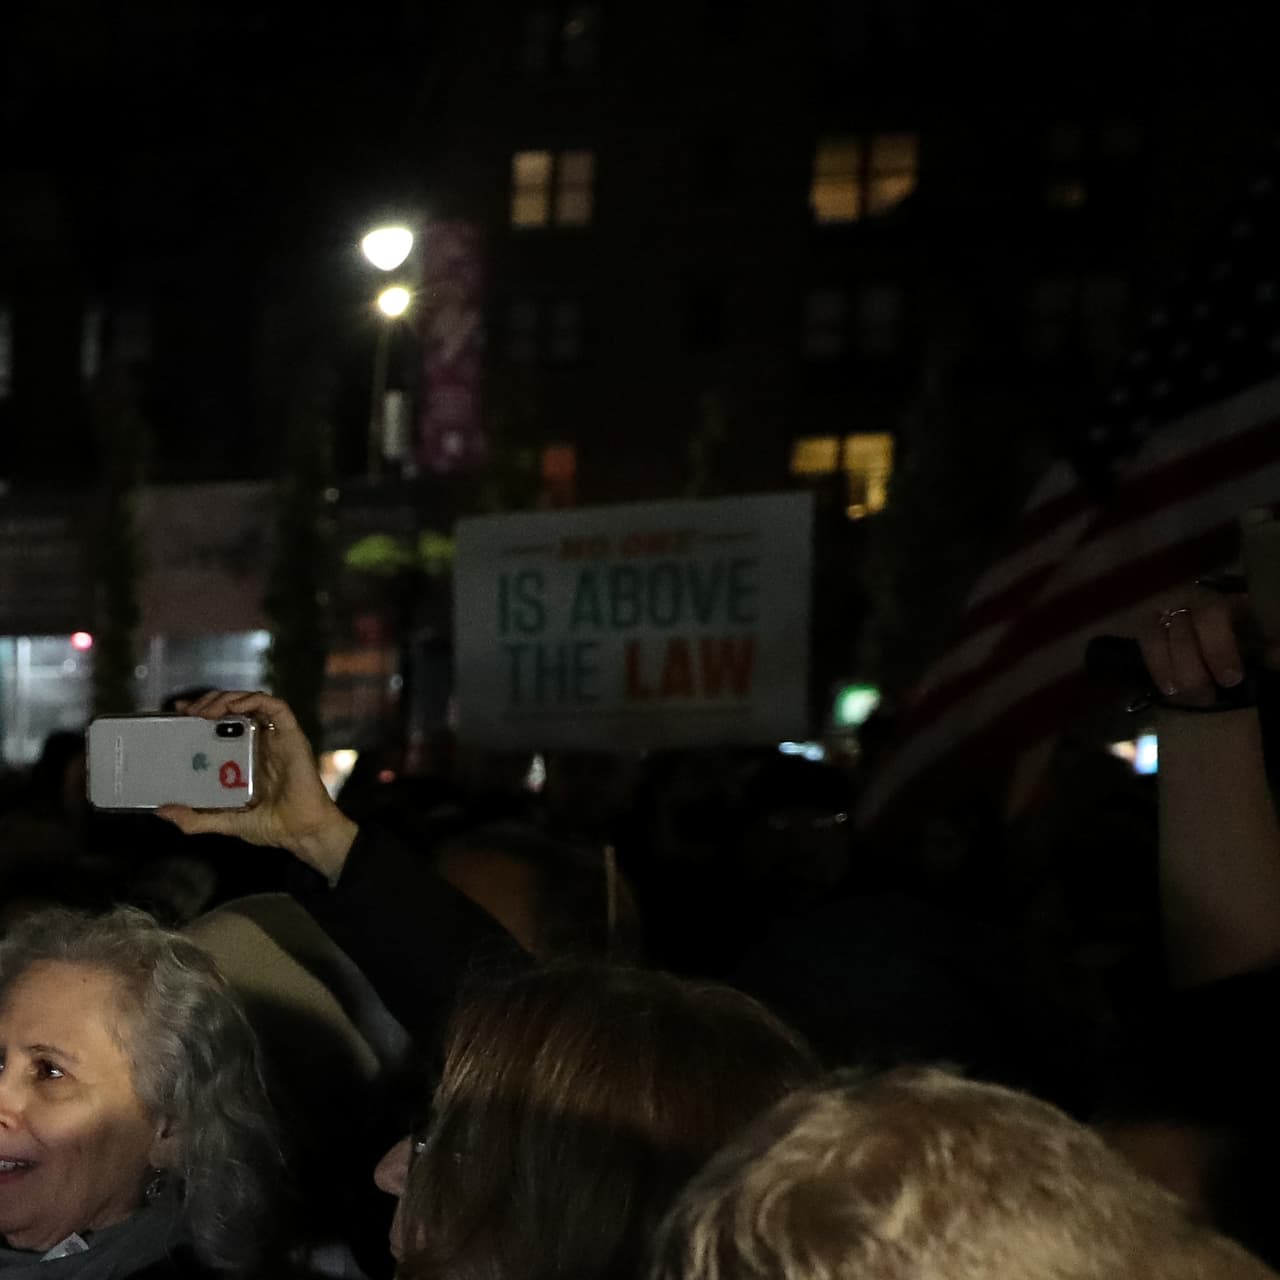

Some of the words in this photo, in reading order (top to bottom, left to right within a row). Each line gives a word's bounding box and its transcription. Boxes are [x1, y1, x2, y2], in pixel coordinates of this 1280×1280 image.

[497, 569, 547, 636] IS
[570, 556, 760, 632] ABOVE
[502, 640, 601, 707] THE
[623, 635, 757, 701] LAW
